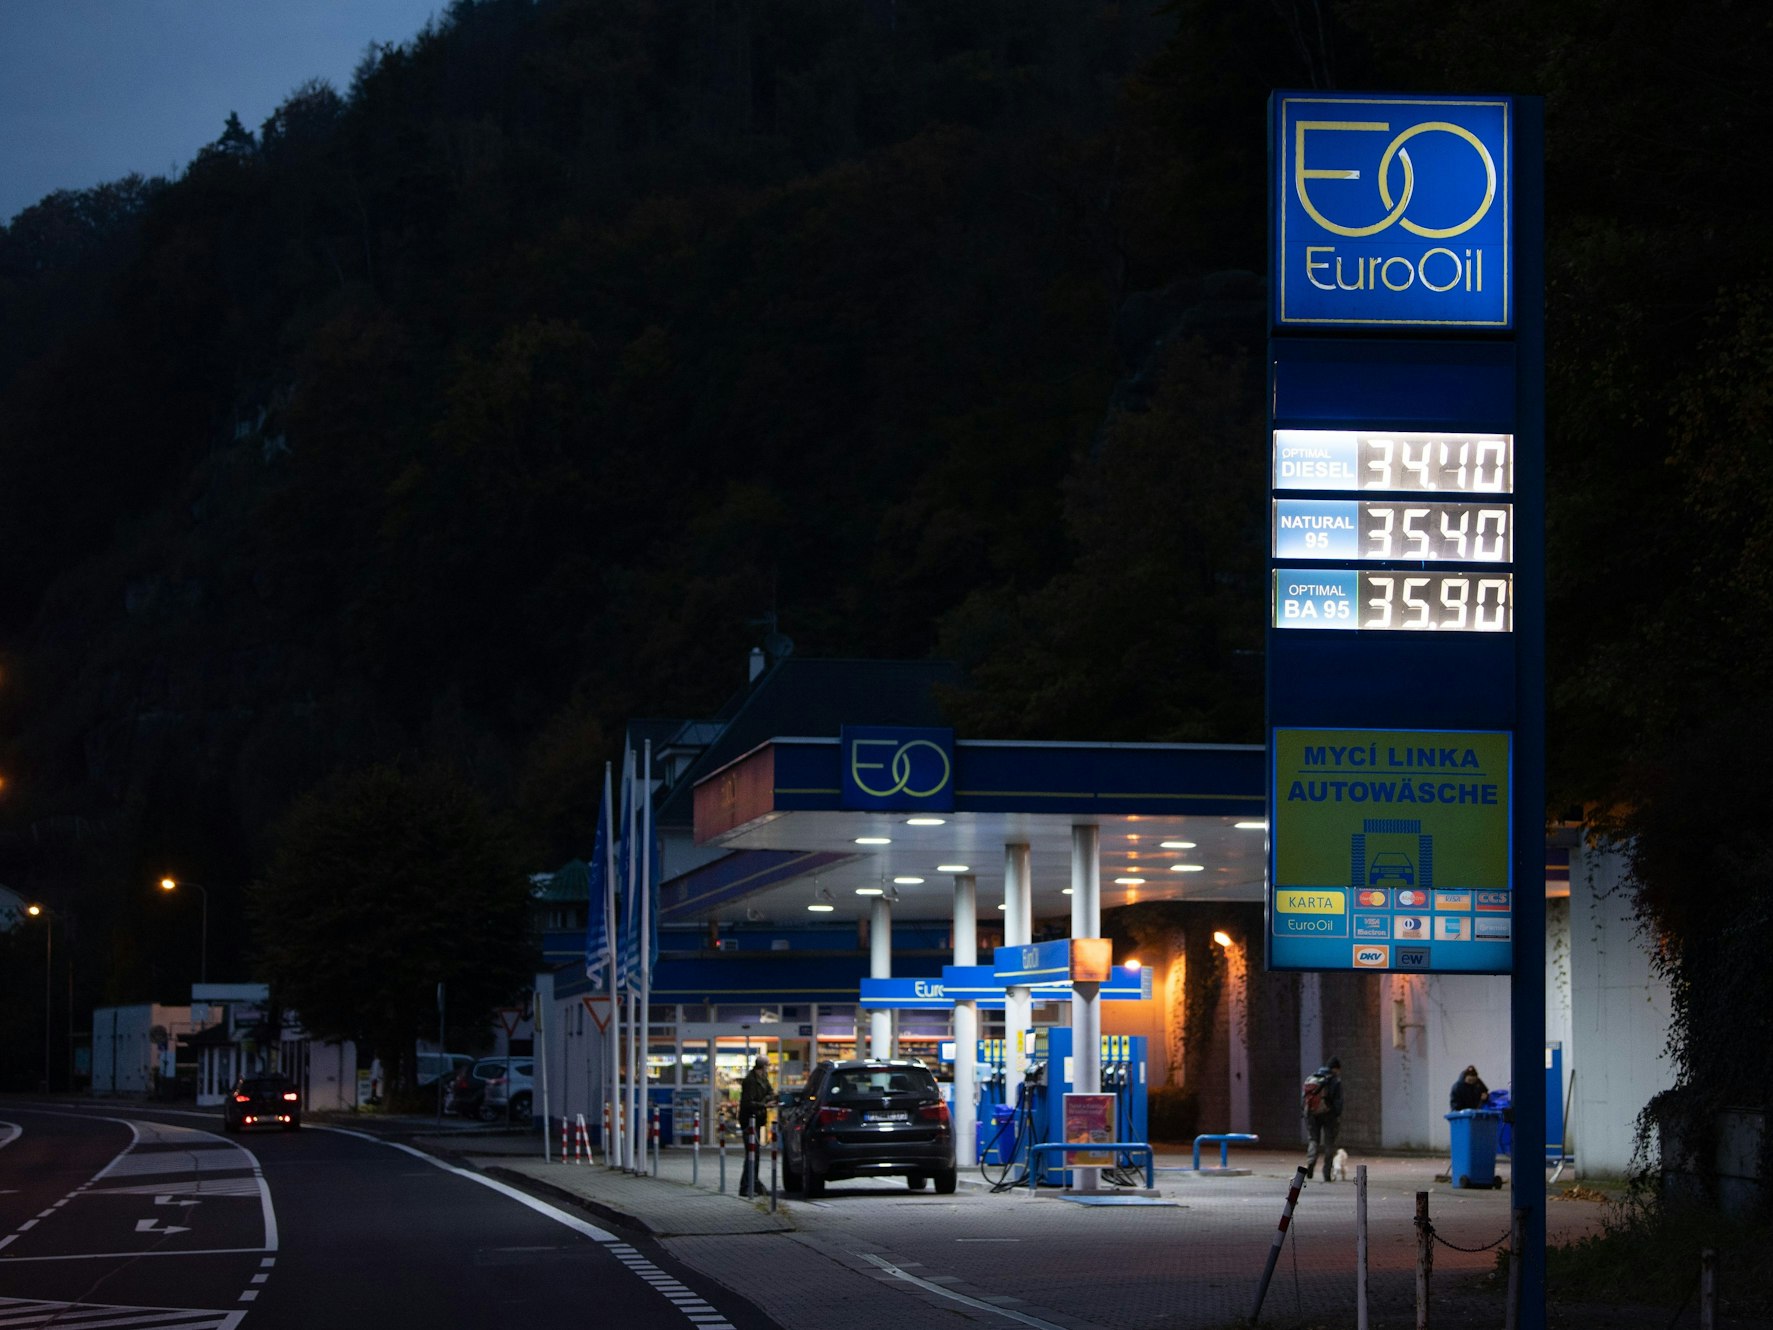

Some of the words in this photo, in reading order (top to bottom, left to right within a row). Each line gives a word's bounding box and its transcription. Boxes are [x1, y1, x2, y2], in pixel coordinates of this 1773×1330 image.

[1306, 246, 1482, 292] EuroOil
[1282, 448, 1331, 459] OPTIMAL
[1282, 461, 1354, 478] DIESEL
[1281, 516, 1354, 530] NATURAL
[1305, 532, 1329, 548] 95
[1288, 584, 1346, 596] OPTIMAL
[1284, 600, 1318, 618] BA
[1323, 600, 1350, 619] 95
[1304, 742, 1377, 767] MYCÍ
[1388, 747, 1480, 769] LINKA
[1287, 778, 1498, 805] AUTOWÄSCHE
[1289, 897, 1333, 909] KARTA
[1478, 893, 1507, 904] CCS
[1288, 919, 1333, 931] EuroOil
[1360, 952, 1382, 961] DKV
